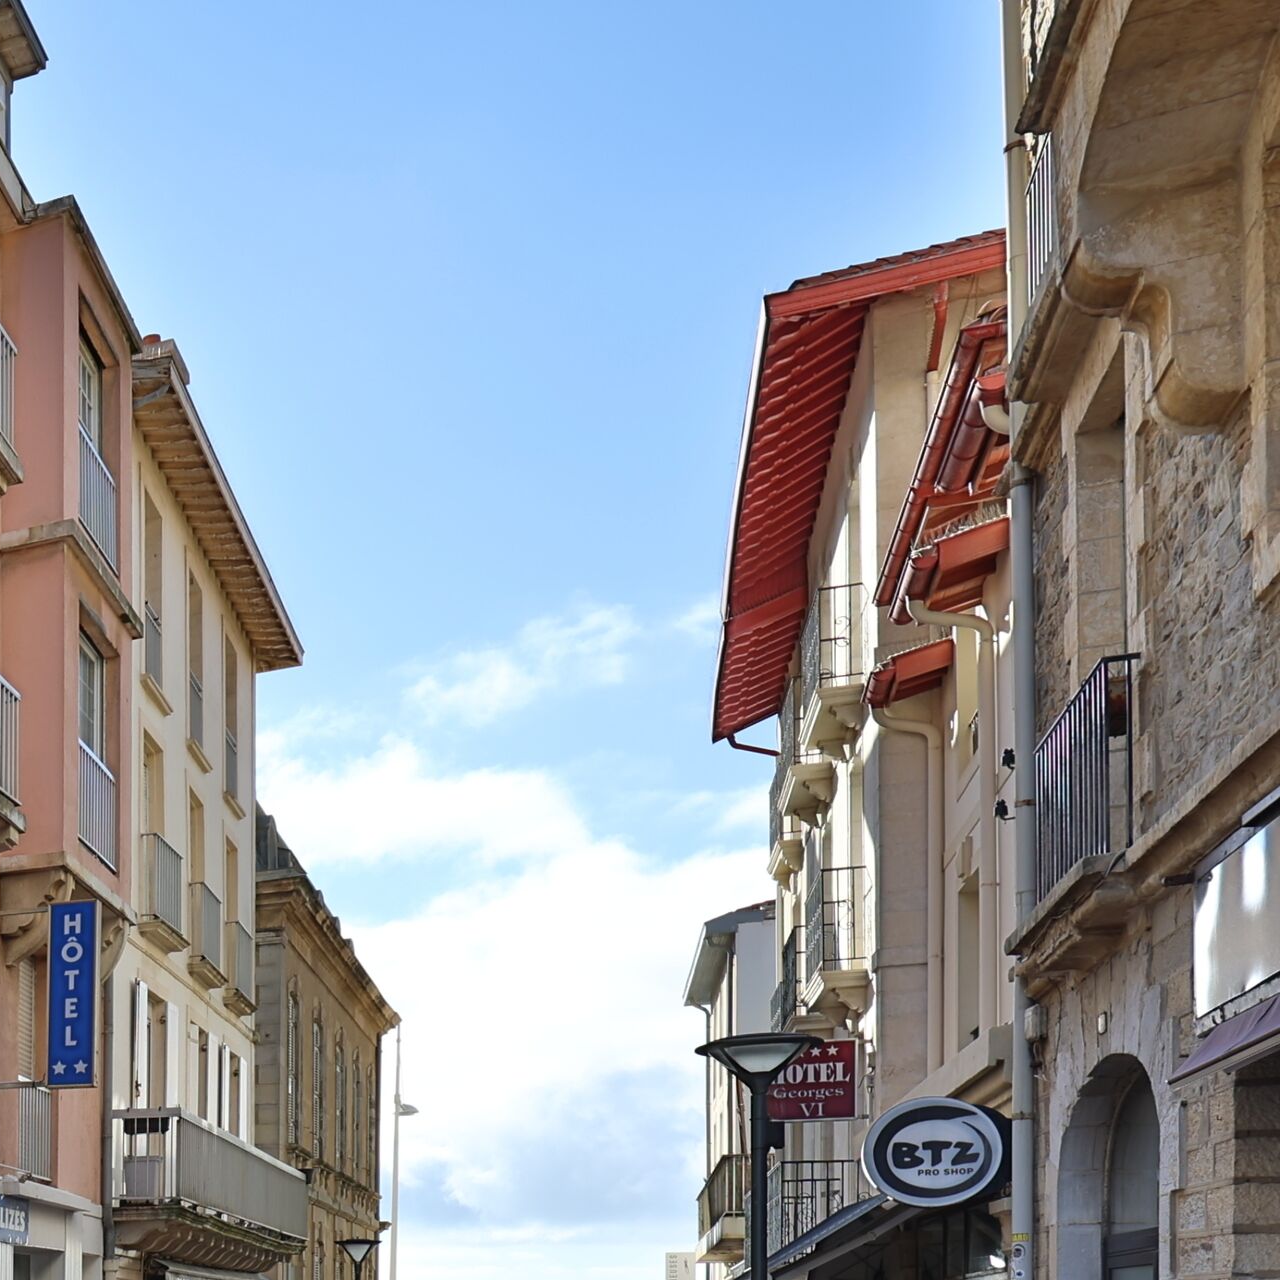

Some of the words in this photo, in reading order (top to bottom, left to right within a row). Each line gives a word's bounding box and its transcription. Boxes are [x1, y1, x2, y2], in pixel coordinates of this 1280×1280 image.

[61, 913, 83, 1046] HÔTEL
[773, 1087, 844, 1100] Georges
[800, 1102, 825, 1117] VI
[892, 1140, 980, 1170] BTZ
[917, 1169, 940, 1177] PRO
[943, 1167, 974, 1176] SHOP
